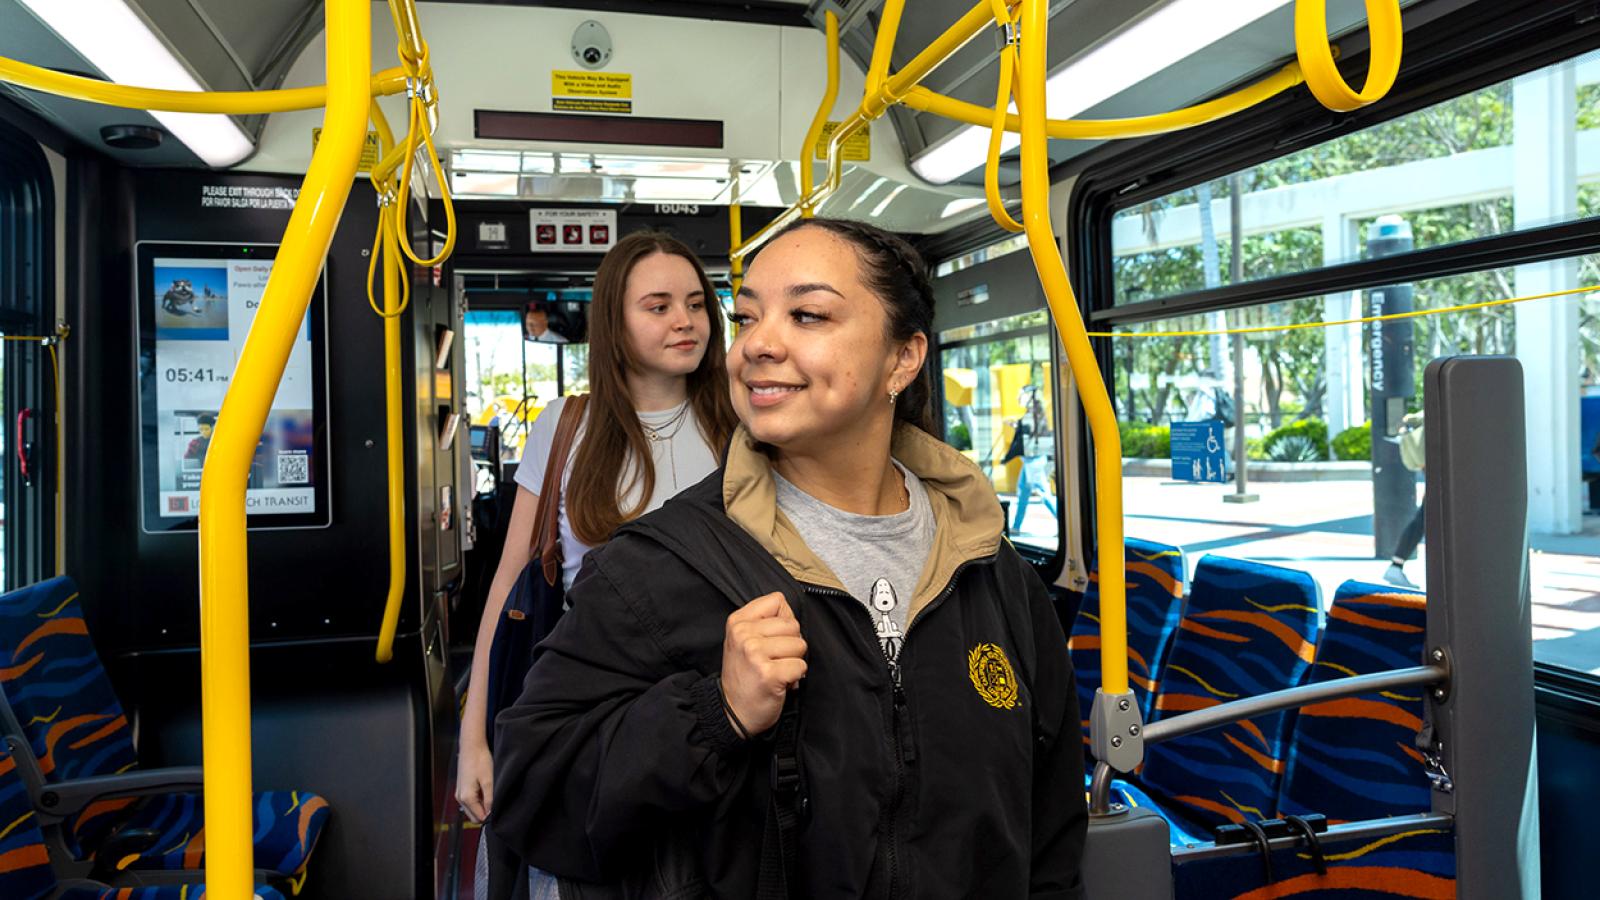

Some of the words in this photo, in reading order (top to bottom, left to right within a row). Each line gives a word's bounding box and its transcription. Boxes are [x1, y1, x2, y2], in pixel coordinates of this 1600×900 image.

[202, 185, 227, 196] PLEASE
[228, 186, 242, 196] EXIT
[243, 187, 274, 197] THROUGH
[201, 197, 213, 207] POR
[214, 197, 231, 207] FAVOR
[232, 198, 248, 208] SALGA
[249, 198, 260, 208] POR
[655, 203, 699, 214] 16043
[1371, 291, 1385, 392] Emergency
[165, 368, 214, 382] 05:41
[265, 496, 309, 507] TRANSIT
